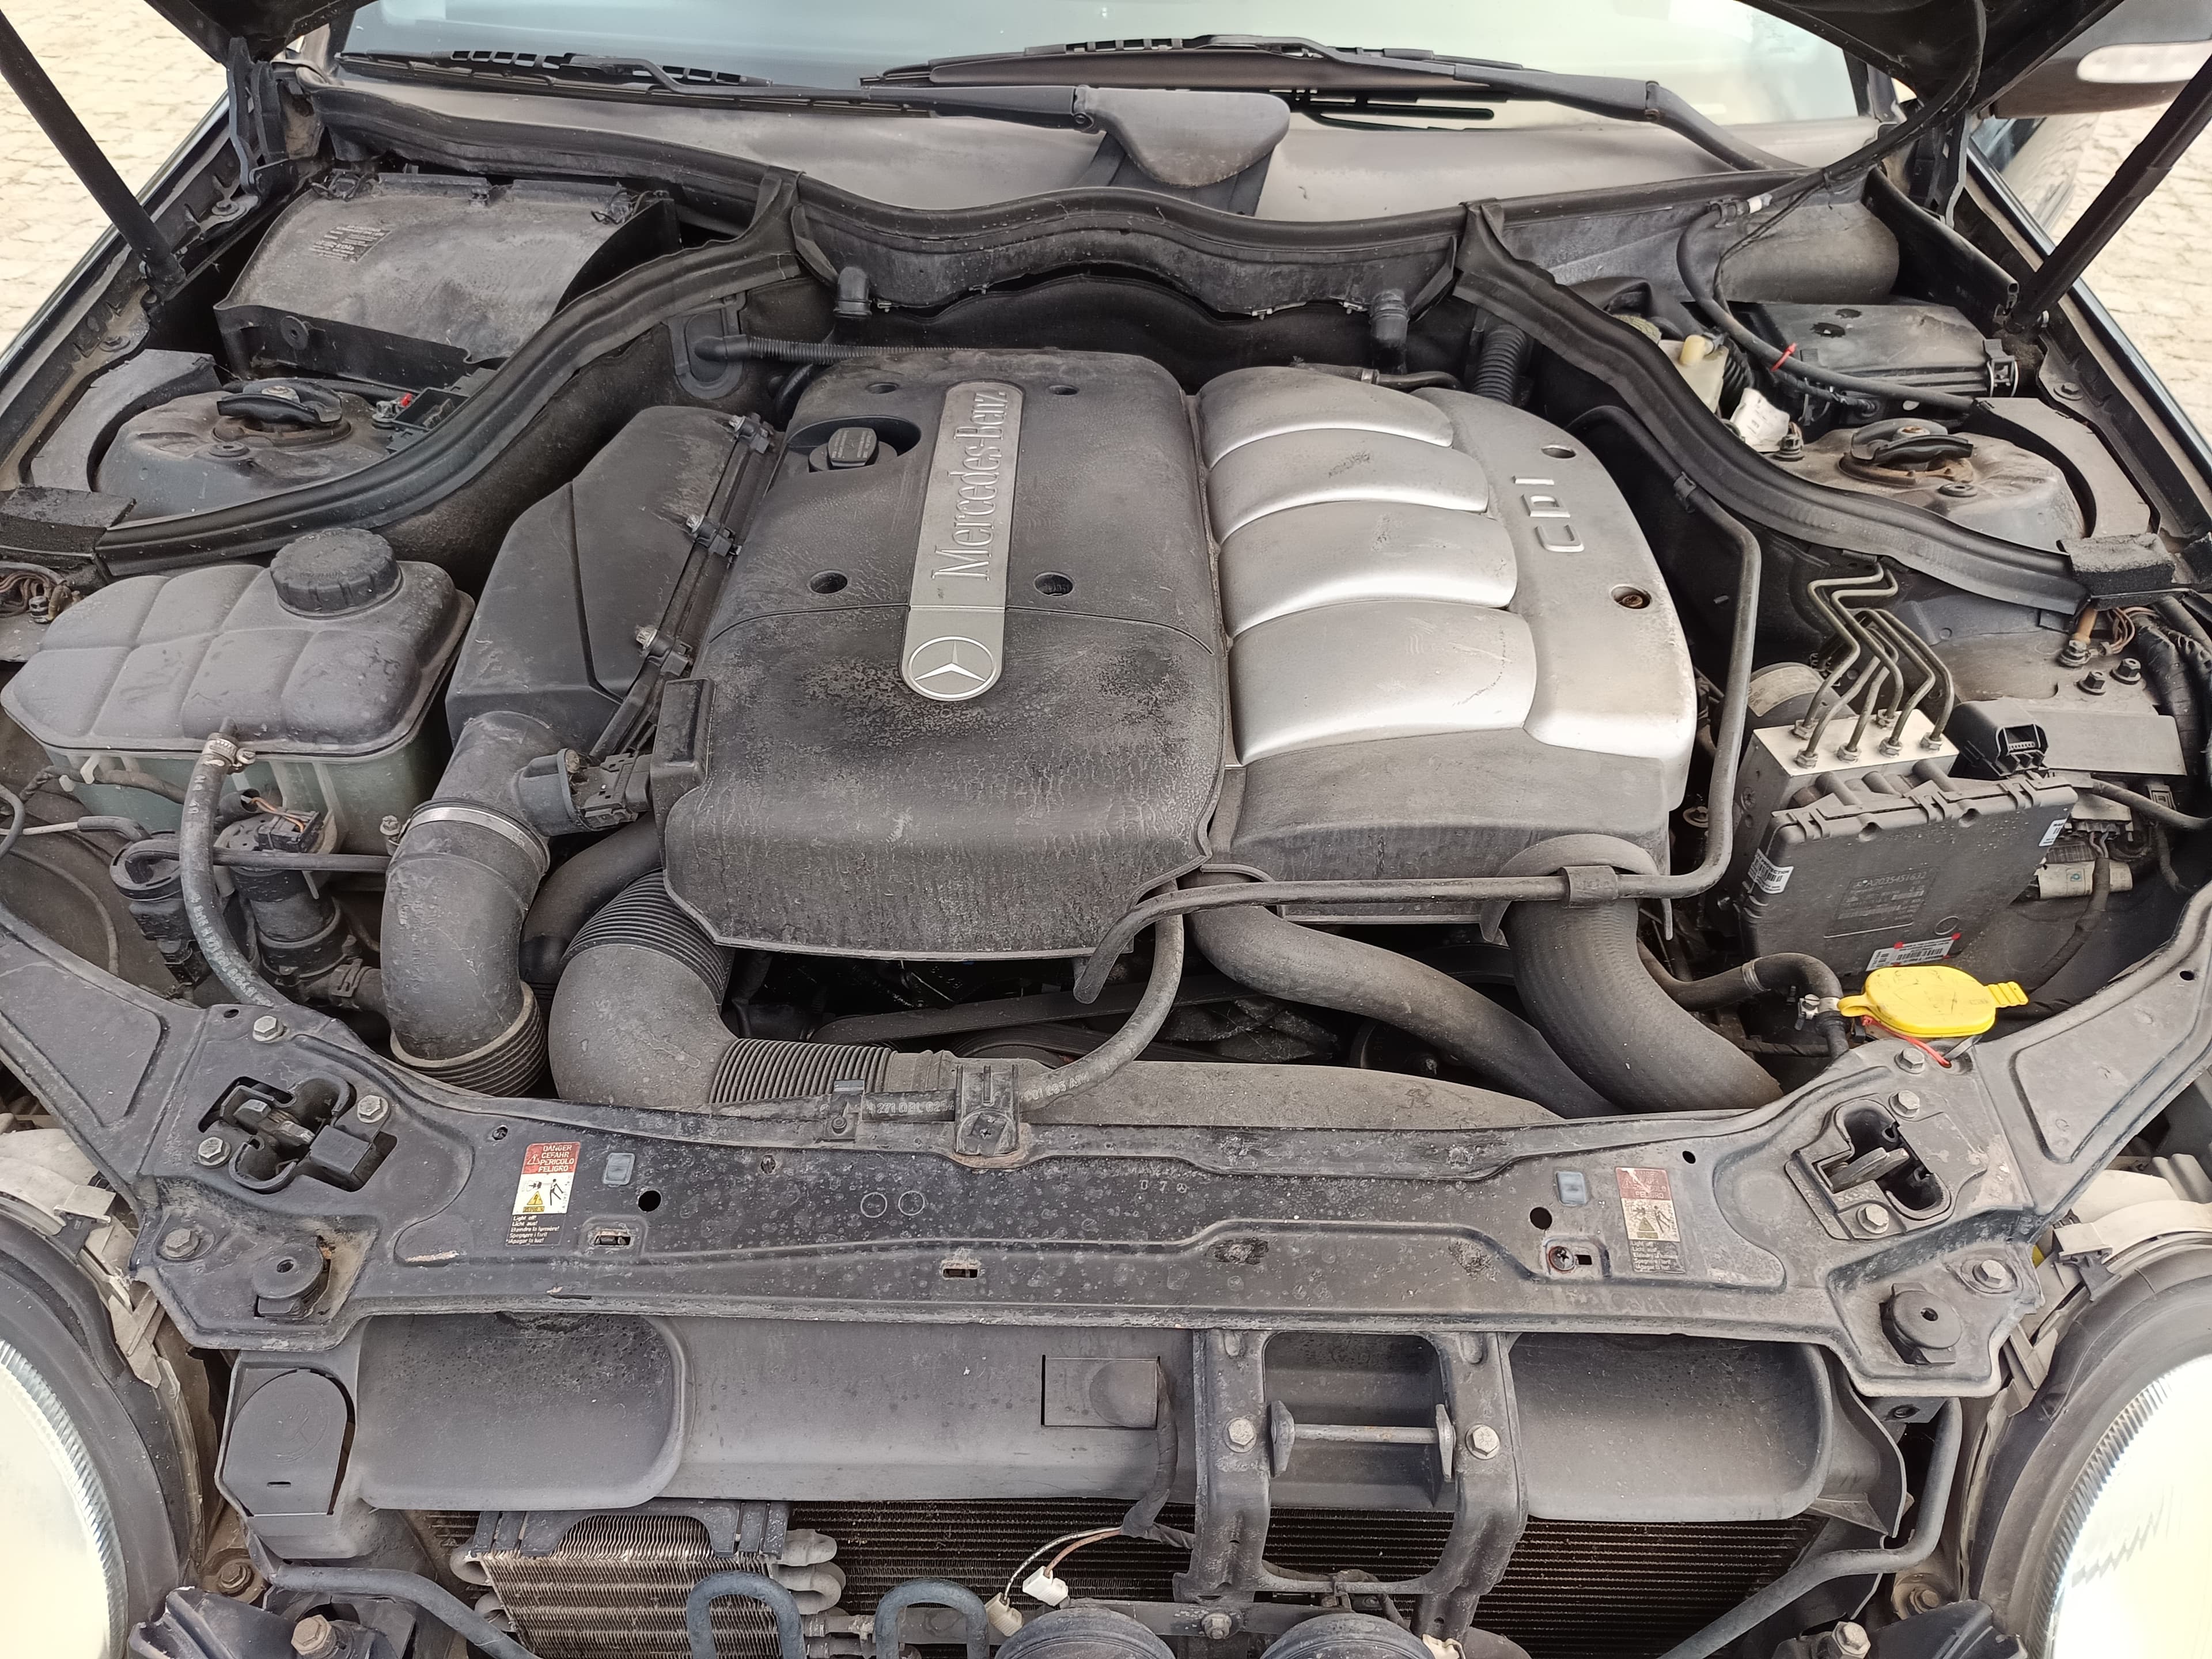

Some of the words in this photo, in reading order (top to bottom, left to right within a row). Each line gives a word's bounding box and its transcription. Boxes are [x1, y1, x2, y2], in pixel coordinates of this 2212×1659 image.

[931, 391, 1008, 582] Mercedes-Benz
[1512, 475, 1585, 553] CDI
[540, 1157, 575, 1166] PERICOLO
[543, 1144, 573, 1152] DANGER
